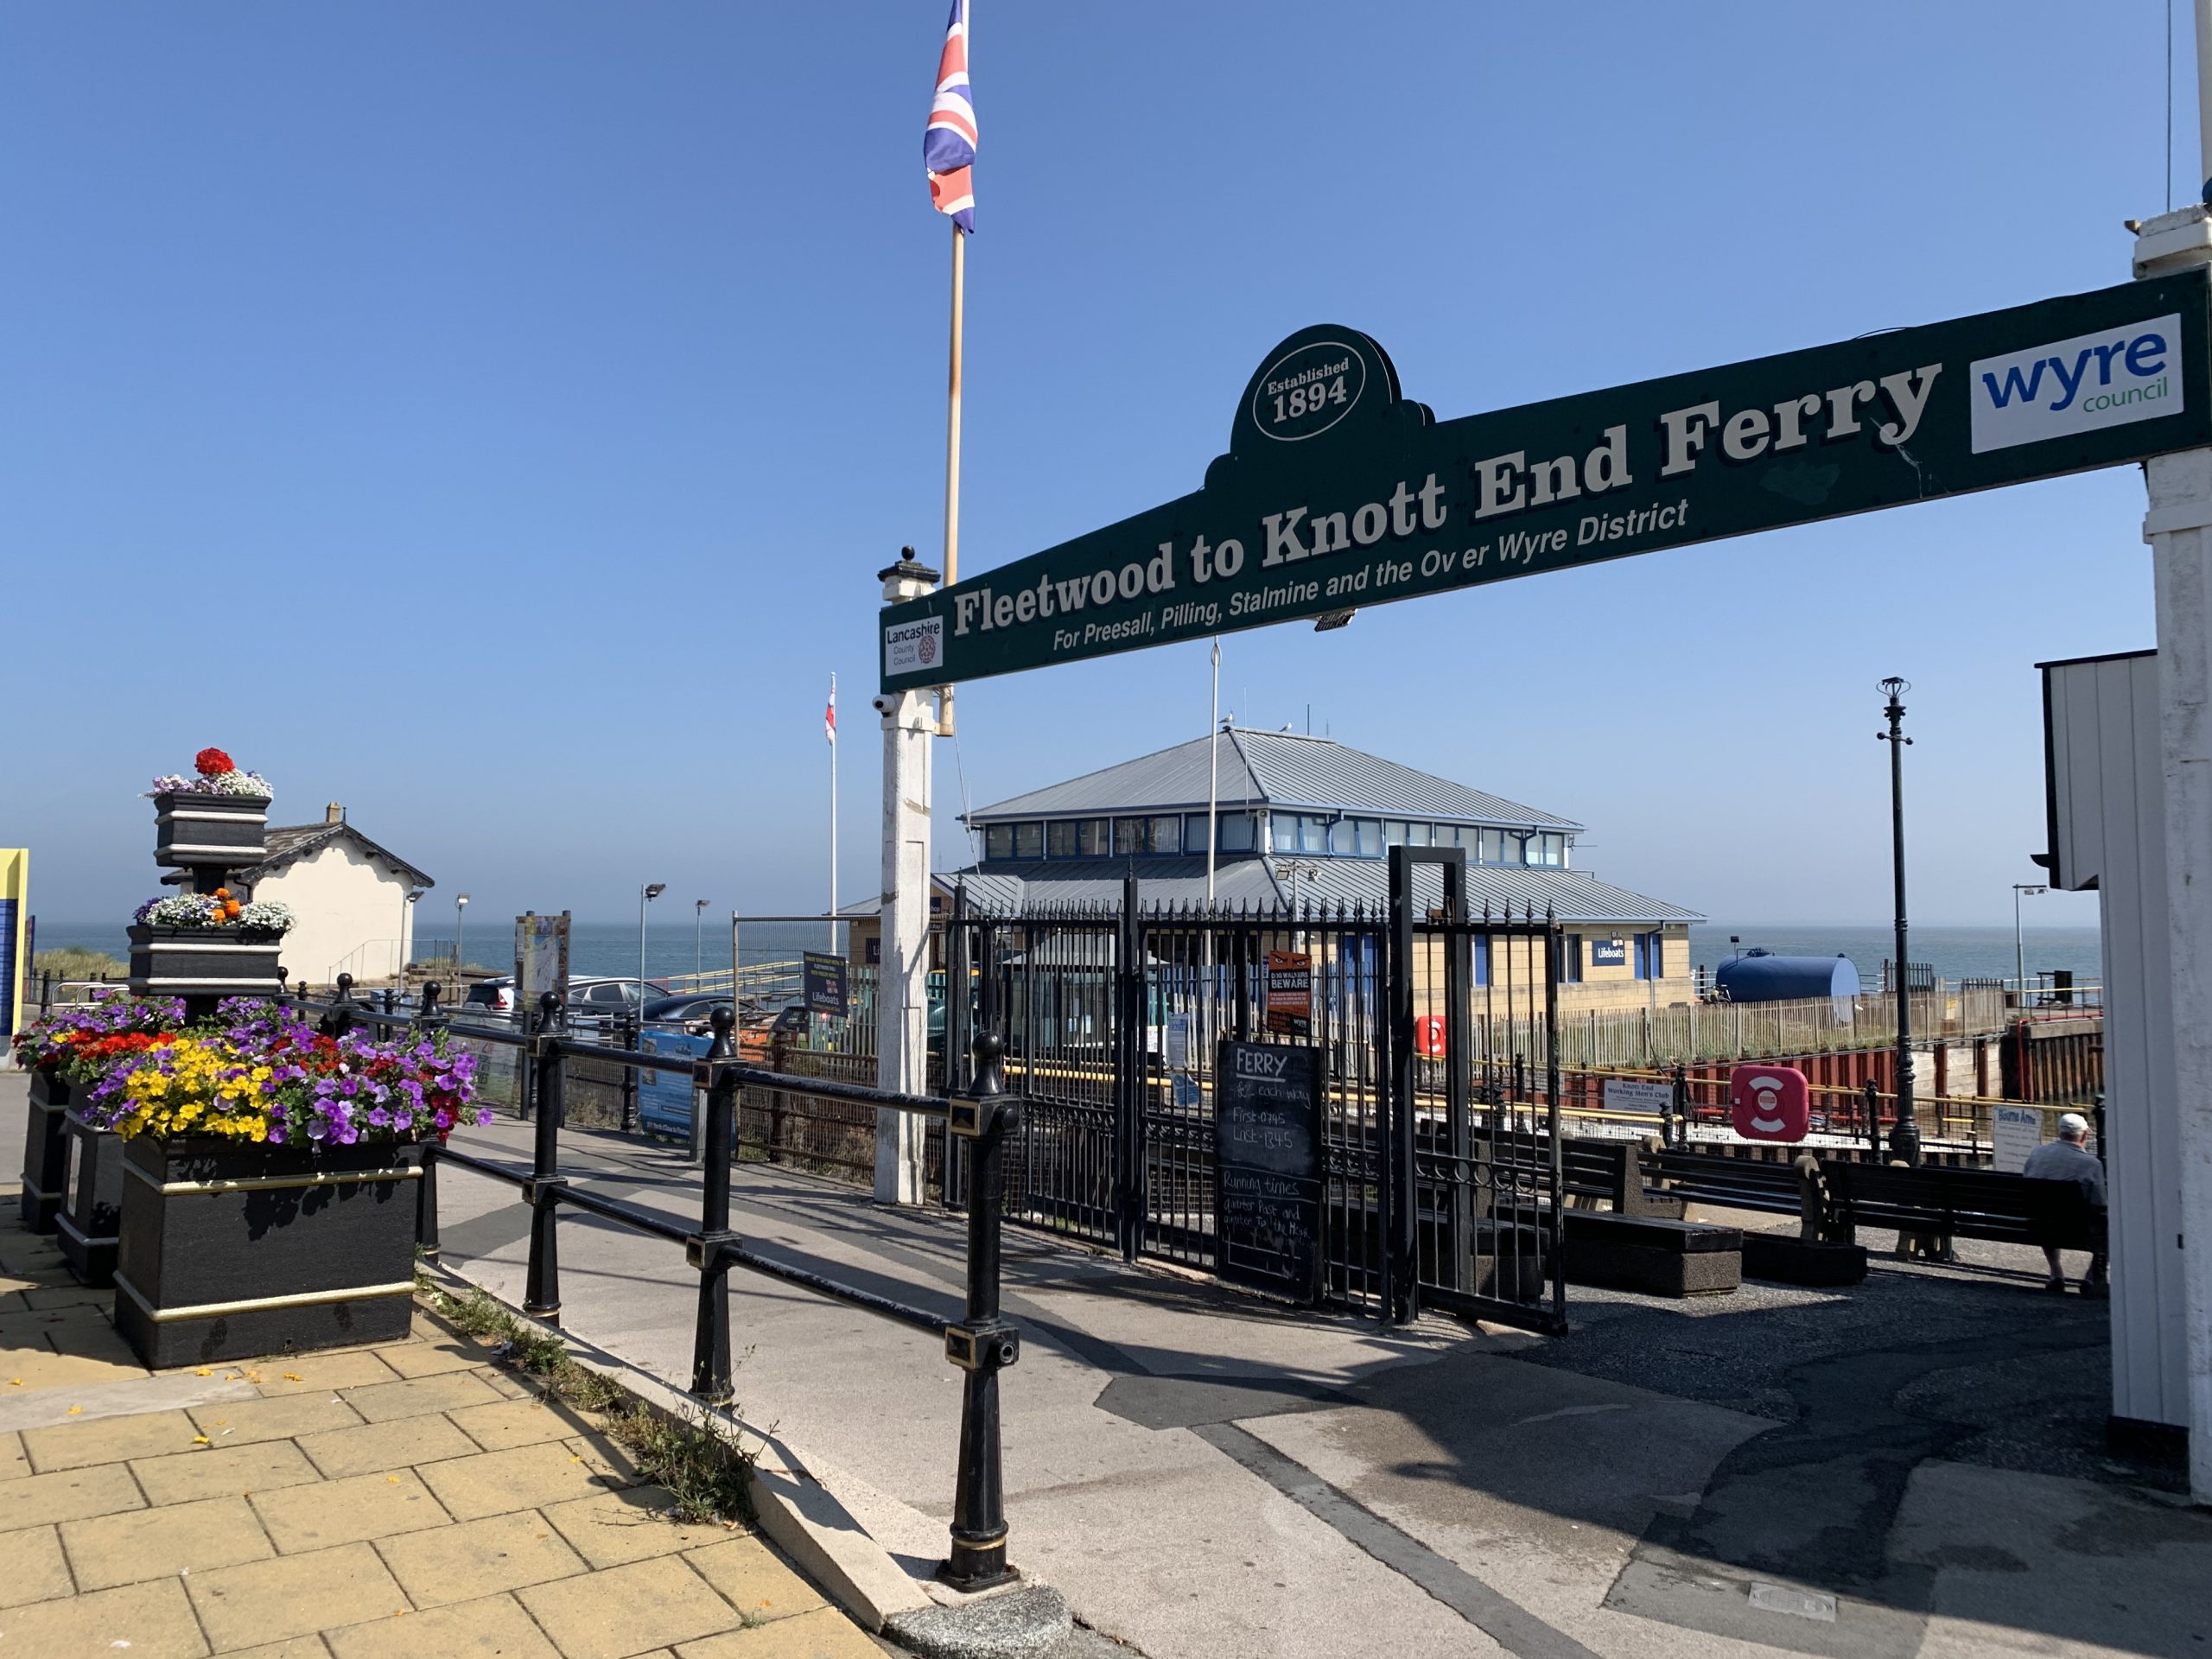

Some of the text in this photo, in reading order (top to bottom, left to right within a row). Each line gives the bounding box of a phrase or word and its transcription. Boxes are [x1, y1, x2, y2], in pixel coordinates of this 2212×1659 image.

[1267, 357, 1350, 396] Established
[1982, 334, 2167, 412] wyre
[1274, 375, 1347, 423] 1894
[2083, 377, 2168, 412] council
[954, 362, 1942, 636] Fleetwood to Knott End Ferry
[1053, 629, 1080, 651] For
[1084, 612, 1155, 645] Preesall,
[1160, 602, 1223, 630] Pilling,
[1229, 582, 1319, 616] Stalmine
[1326, 564, 1370, 596] and
[1376, 560, 1413, 587] the
[1498, 529, 1567, 566] Wyre
[1577, 499, 1688, 546] District
[887, 621, 940, 645] Lancashire
[893, 645, 914, 655] County
[893, 653, 916, 666] Council
[1598, 947, 1624, 958] Lifeboats
[1271, 978, 1309, 989] BEWARE
[812, 991, 840, 1006] Lifeboats
[1236, 1047, 1288, 1077] FERRY
[1258, 1084, 1282, 1098] each
[1287, 1088, 1312, 1110] way
[1607, 1087, 1633, 1096] Working
[1224, 1170, 1300, 1197] Running times
[1282, 1203, 1300, 1222] and
[1274, 1218, 1288, 1236] the
